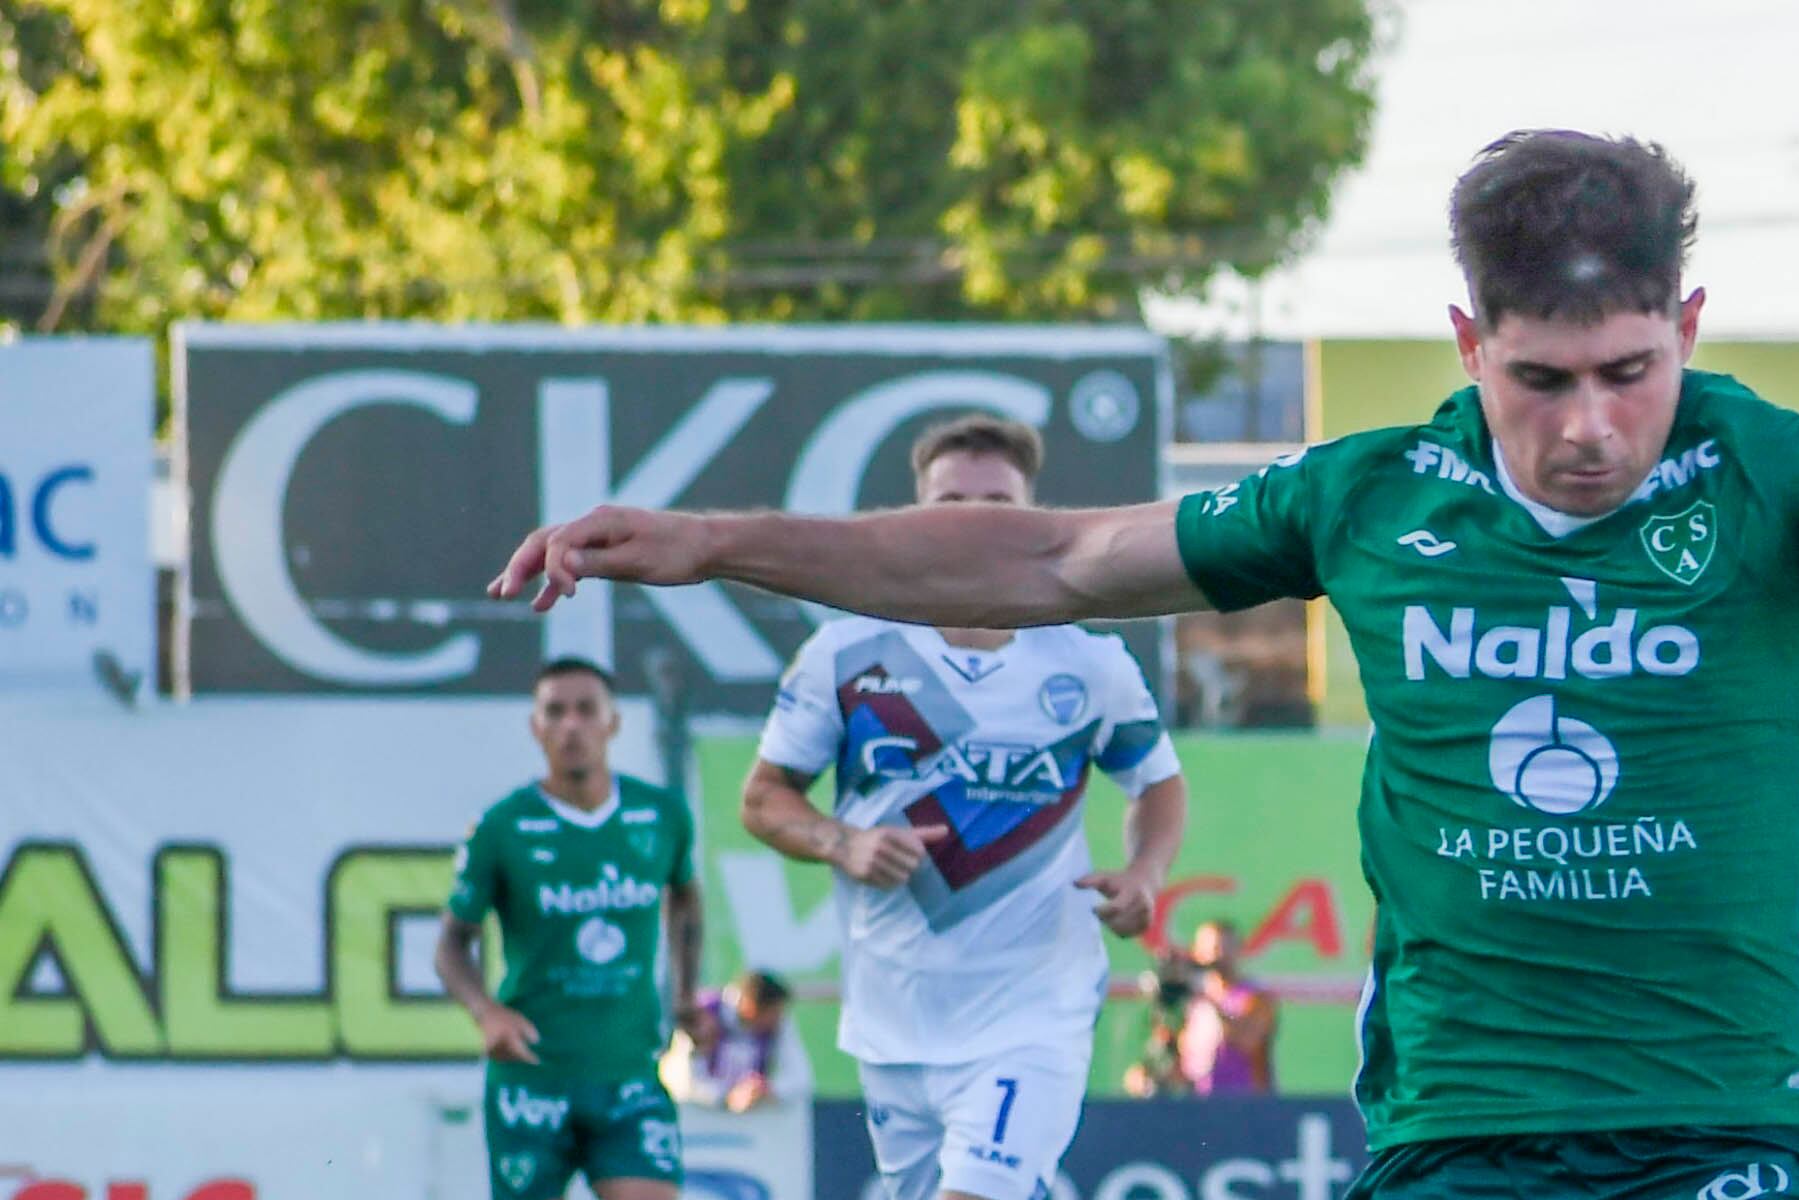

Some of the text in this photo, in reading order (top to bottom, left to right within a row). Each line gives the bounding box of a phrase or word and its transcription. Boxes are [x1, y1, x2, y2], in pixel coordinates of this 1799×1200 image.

[1402, 577, 1700, 682] Naldo
[1437, 816, 1697, 864] LA PEQUEÑA
[1479, 867, 1652, 900] FAMILIA
[992, 1077, 1018, 1145] 7
